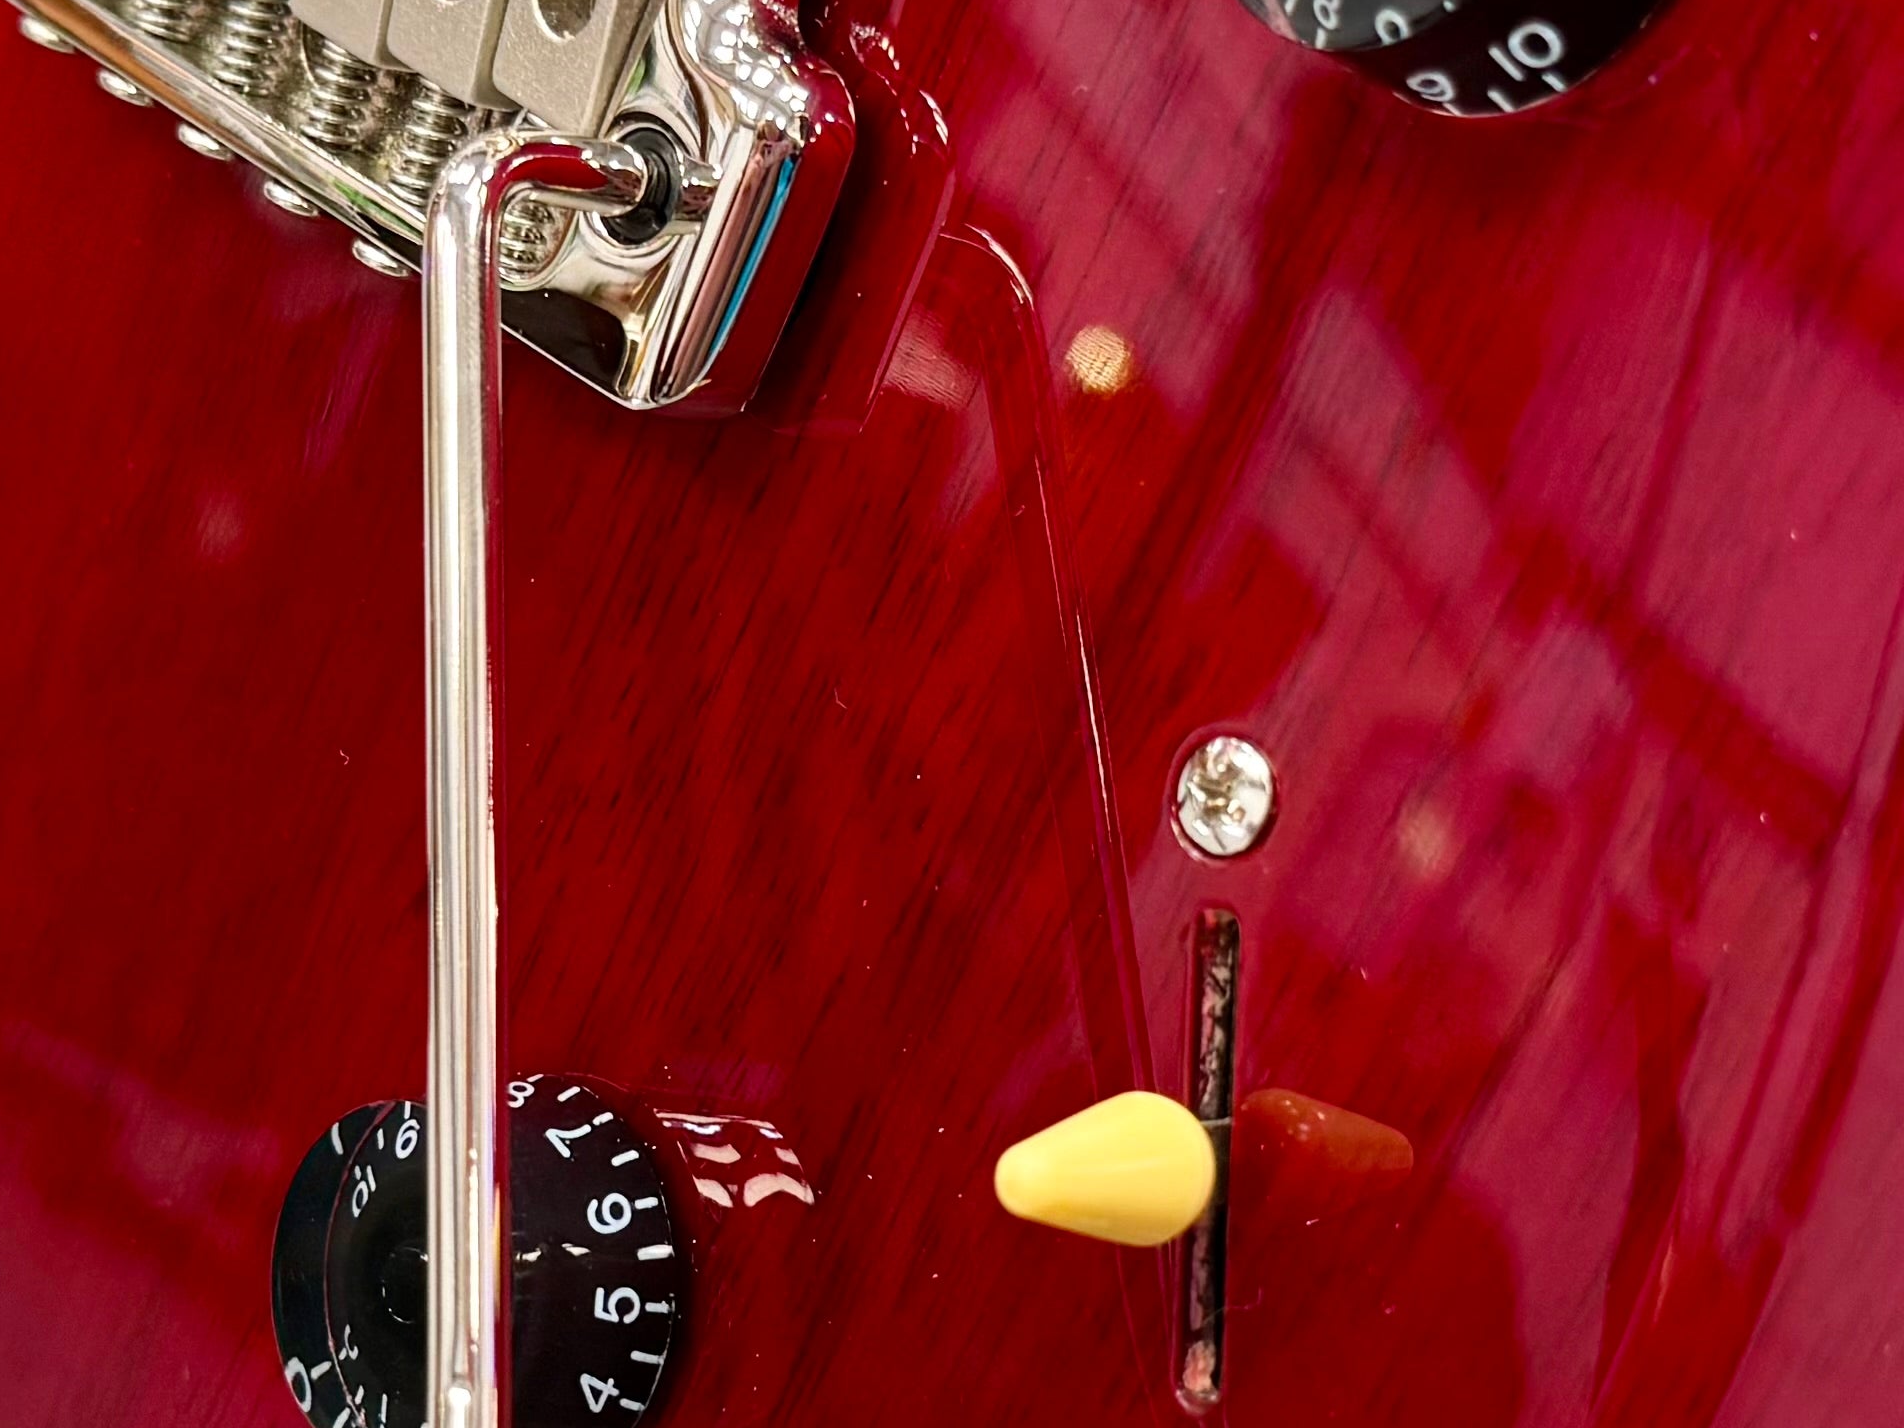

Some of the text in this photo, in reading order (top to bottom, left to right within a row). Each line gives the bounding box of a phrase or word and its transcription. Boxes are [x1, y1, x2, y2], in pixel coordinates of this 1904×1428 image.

[1487, 20, 1565, 83] 10
[544, 1123, 593, 1159] 7
[586, 1192, 633, 1235] 6
[593, 1286, 642, 1325] 5
[579, 1372, 621, 1414] 4
